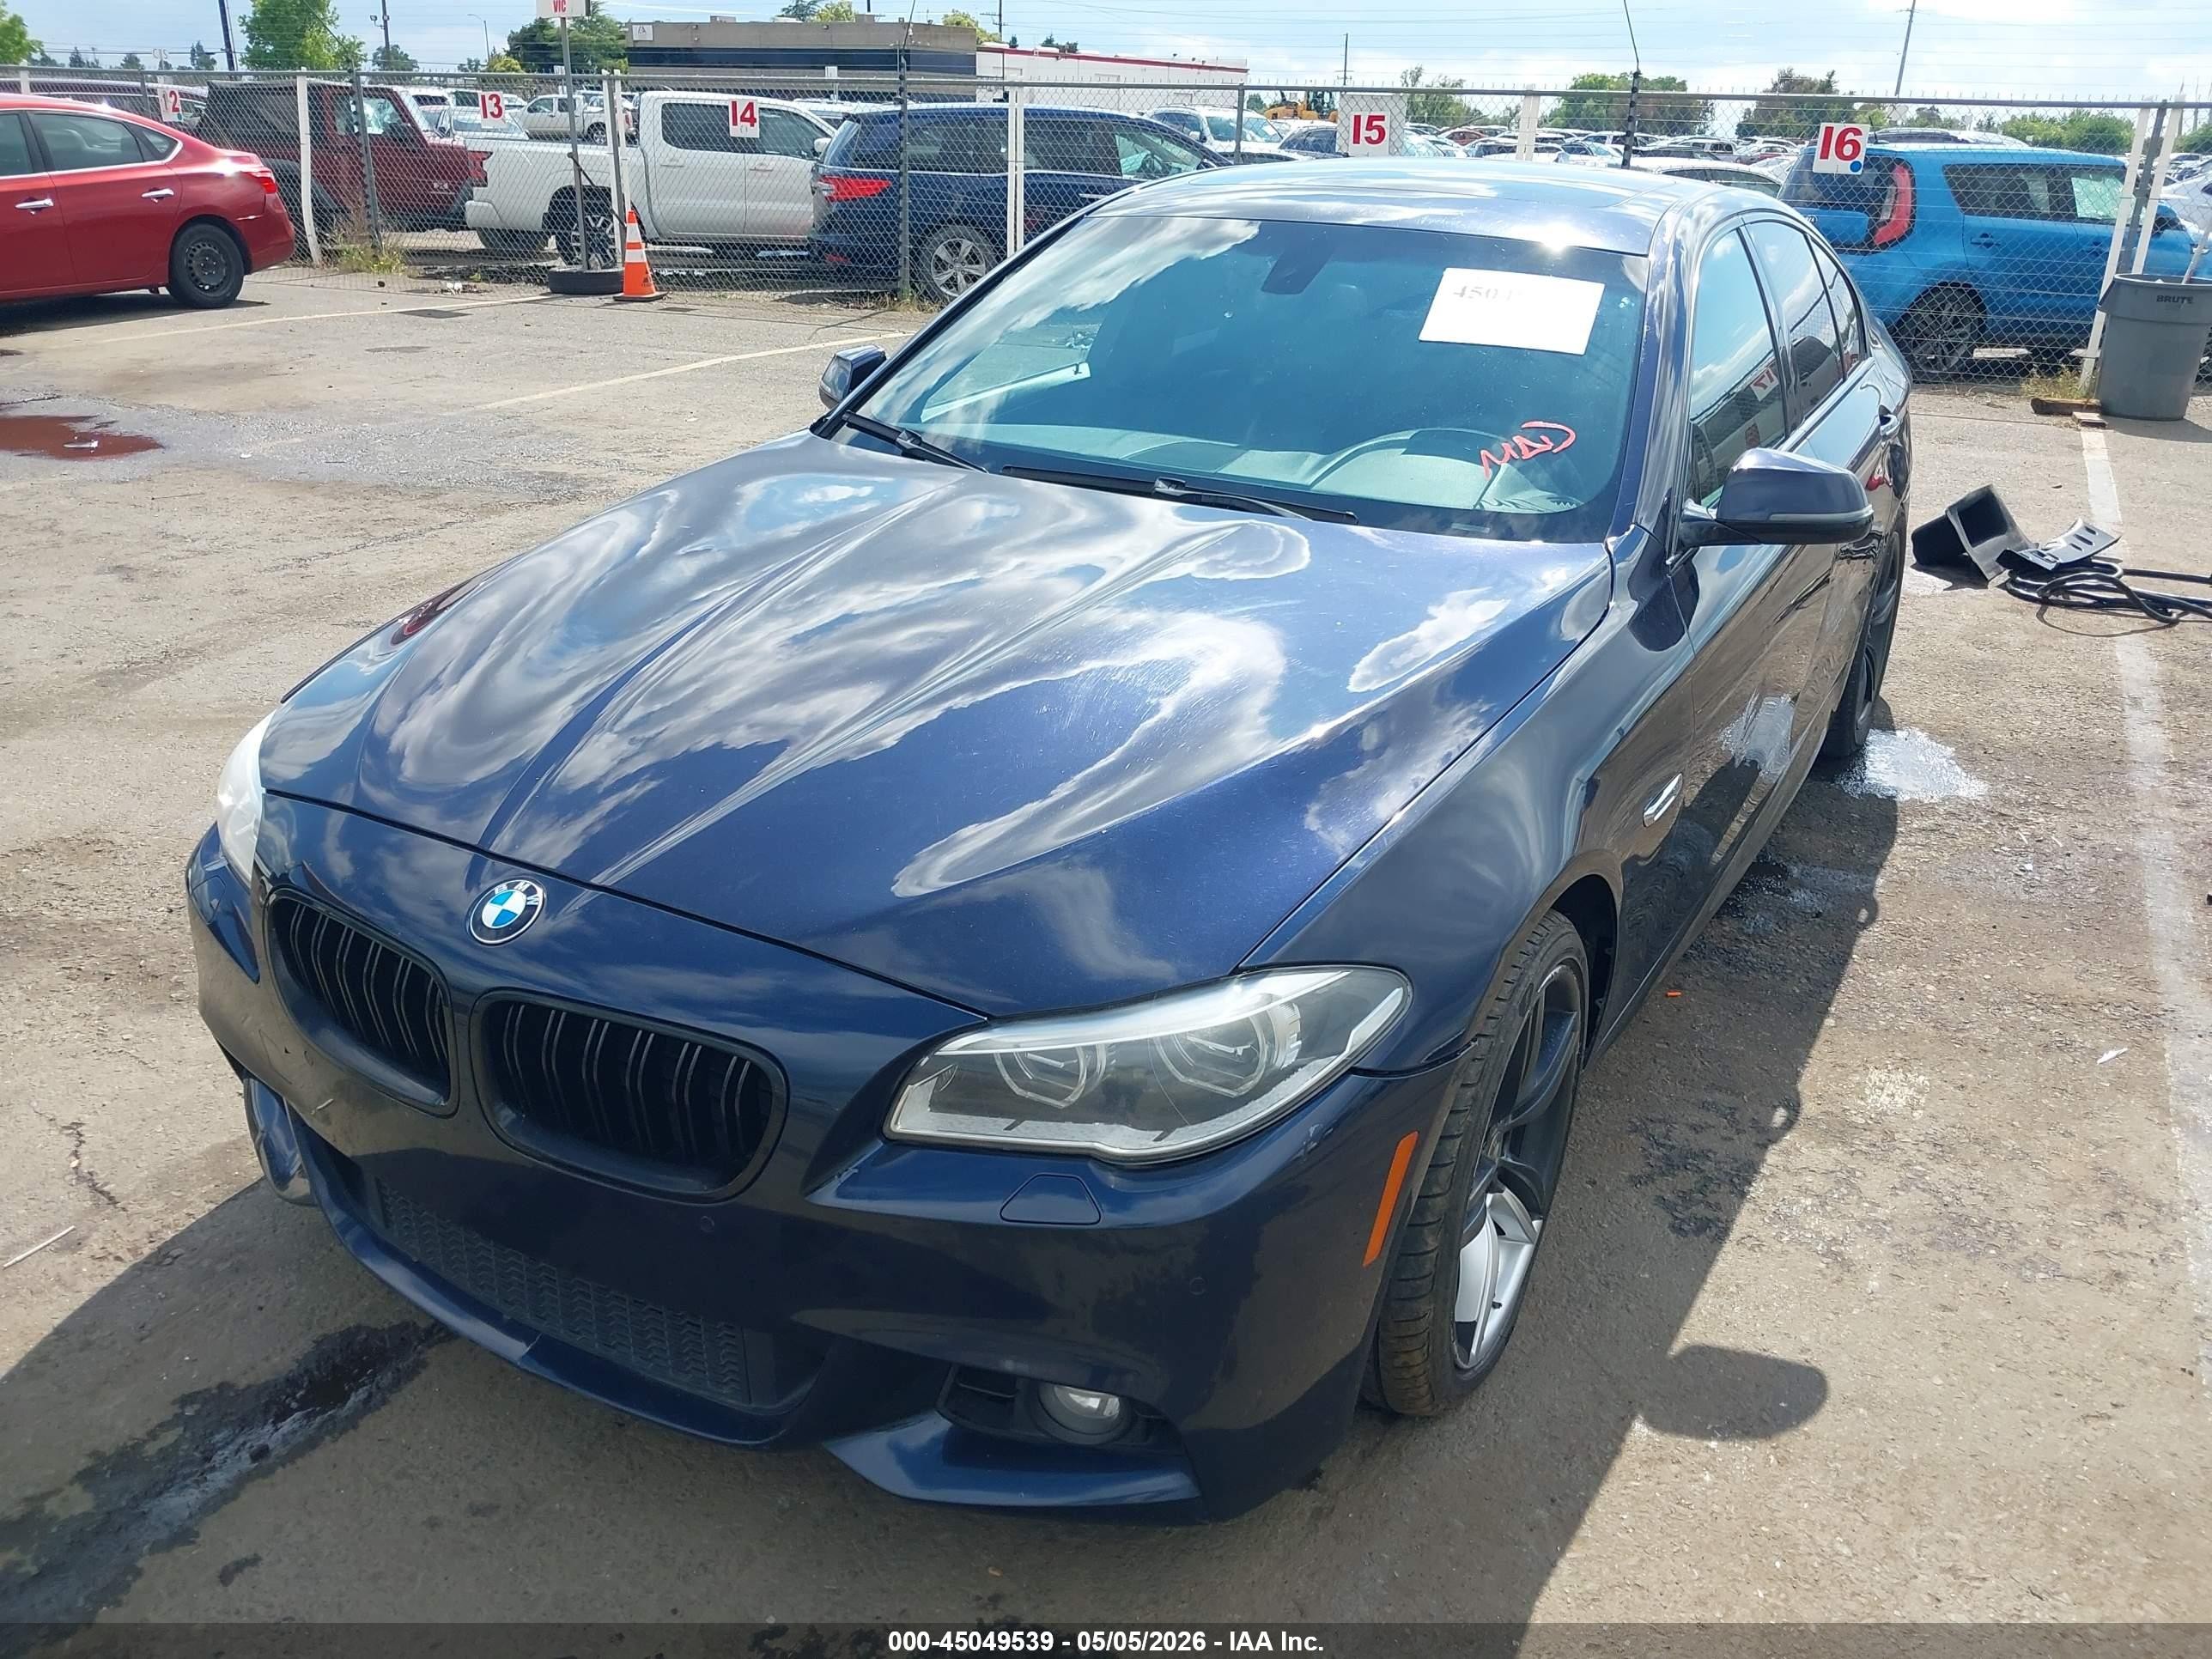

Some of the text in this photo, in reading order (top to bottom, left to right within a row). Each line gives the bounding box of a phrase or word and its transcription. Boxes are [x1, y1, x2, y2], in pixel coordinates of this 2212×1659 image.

[553, 0, 567, 13] VIC
[481, 94, 503, 118] 13
[732, 100, 757, 127] 14
[1352, 114, 1386, 144] 15
[1820, 126, 1863, 161] 16
[2156, 295, 2194, 304] BRUTE
[494, 880, 542, 906] BMW
